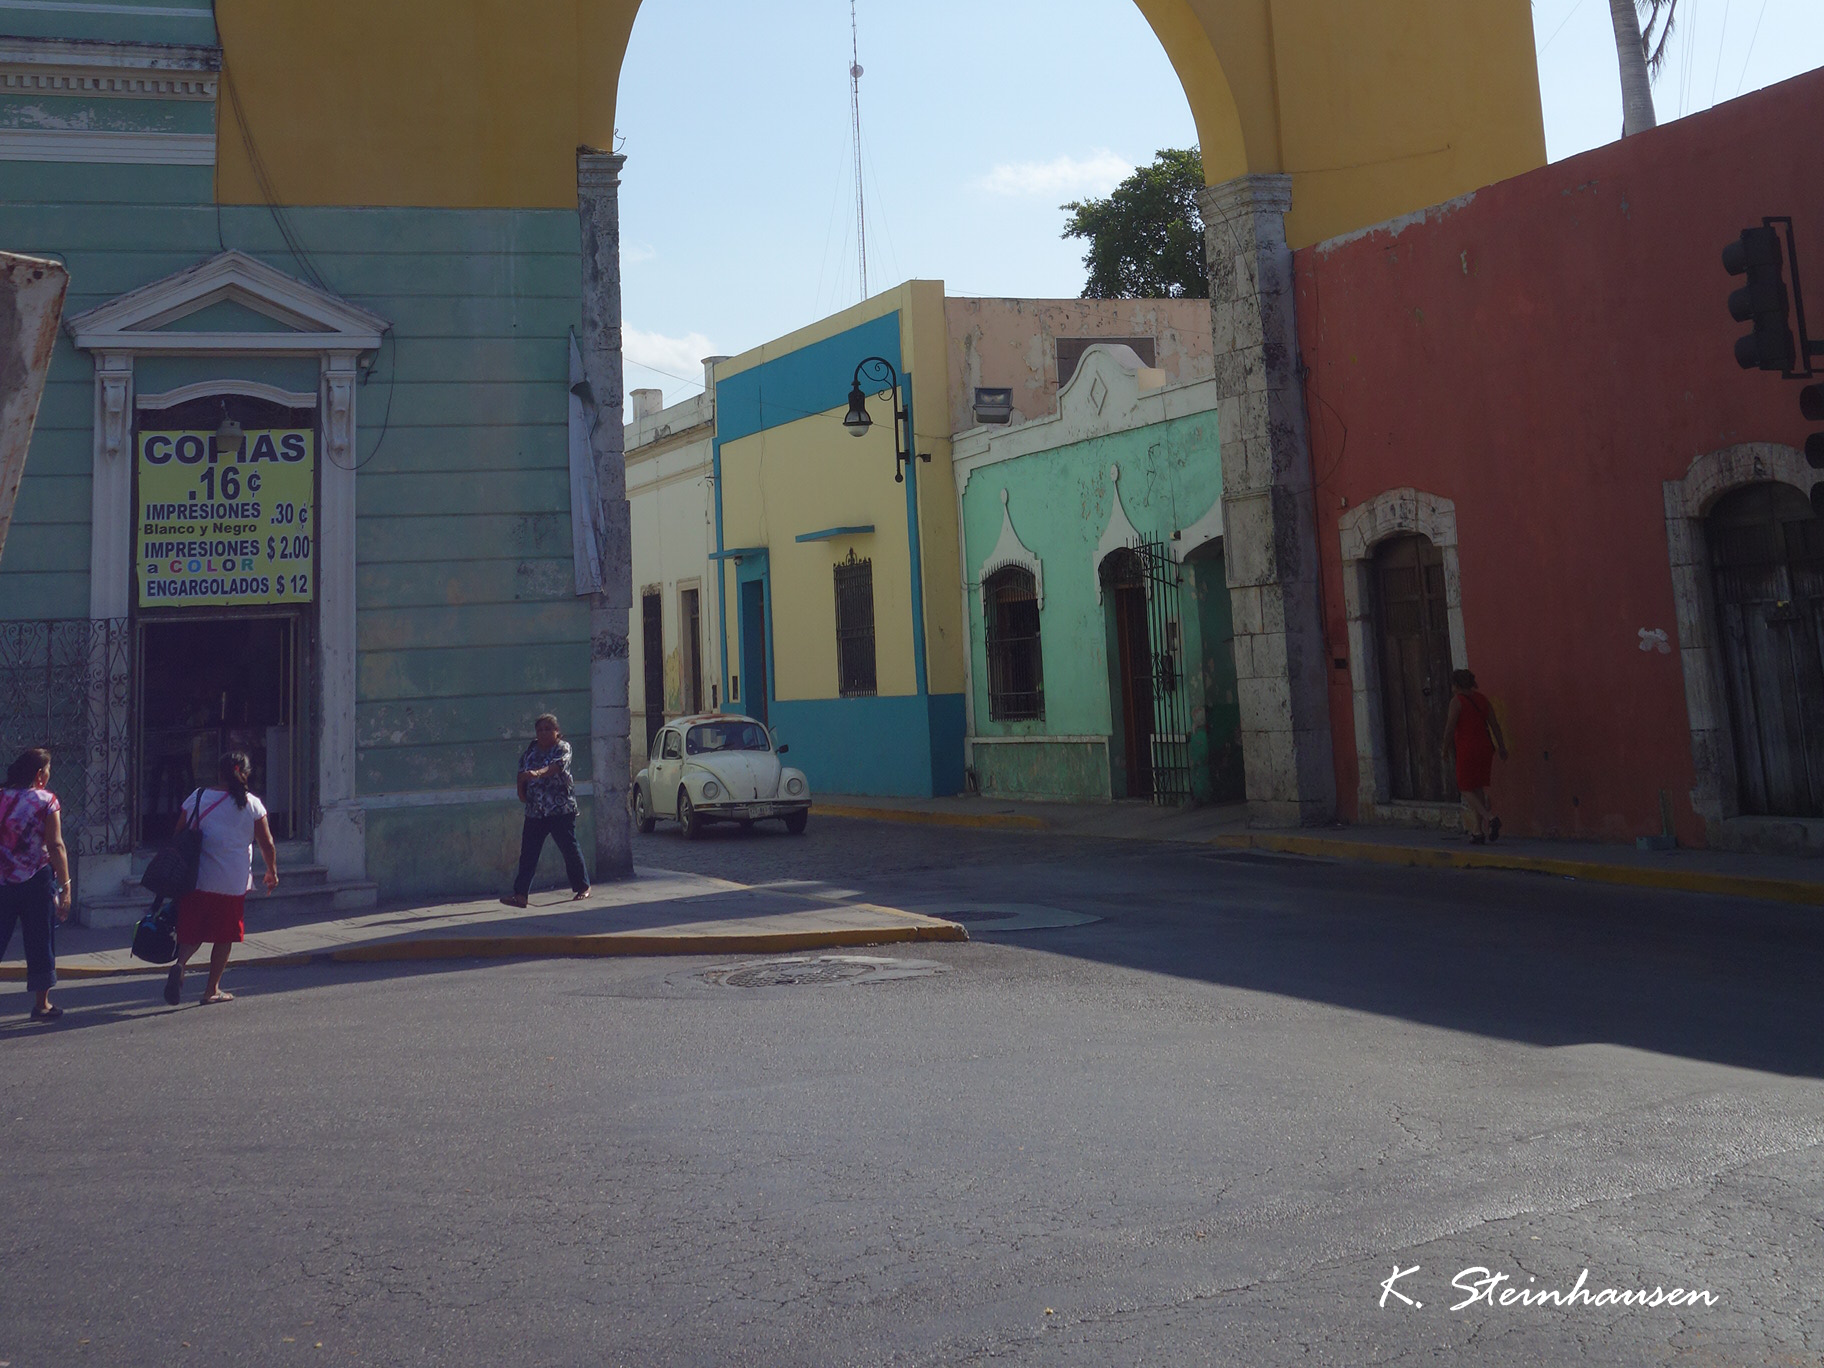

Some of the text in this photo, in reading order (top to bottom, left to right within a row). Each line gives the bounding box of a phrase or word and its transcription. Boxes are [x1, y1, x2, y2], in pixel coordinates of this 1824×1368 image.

[189, 466, 240, 501] .16
[146, 503, 261, 520] IMPRESIONES
[271, 503, 293, 524] .30
[144, 523, 257, 536] Blanco y Negro
[145, 540, 259, 558] IMPRESIONES
[280, 536, 310, 559] 2.00
[148, 563, 158, 573] a
[147, 577, 269, 597] ENGARGOLADOS
[291, 575, 307, 593] 12
